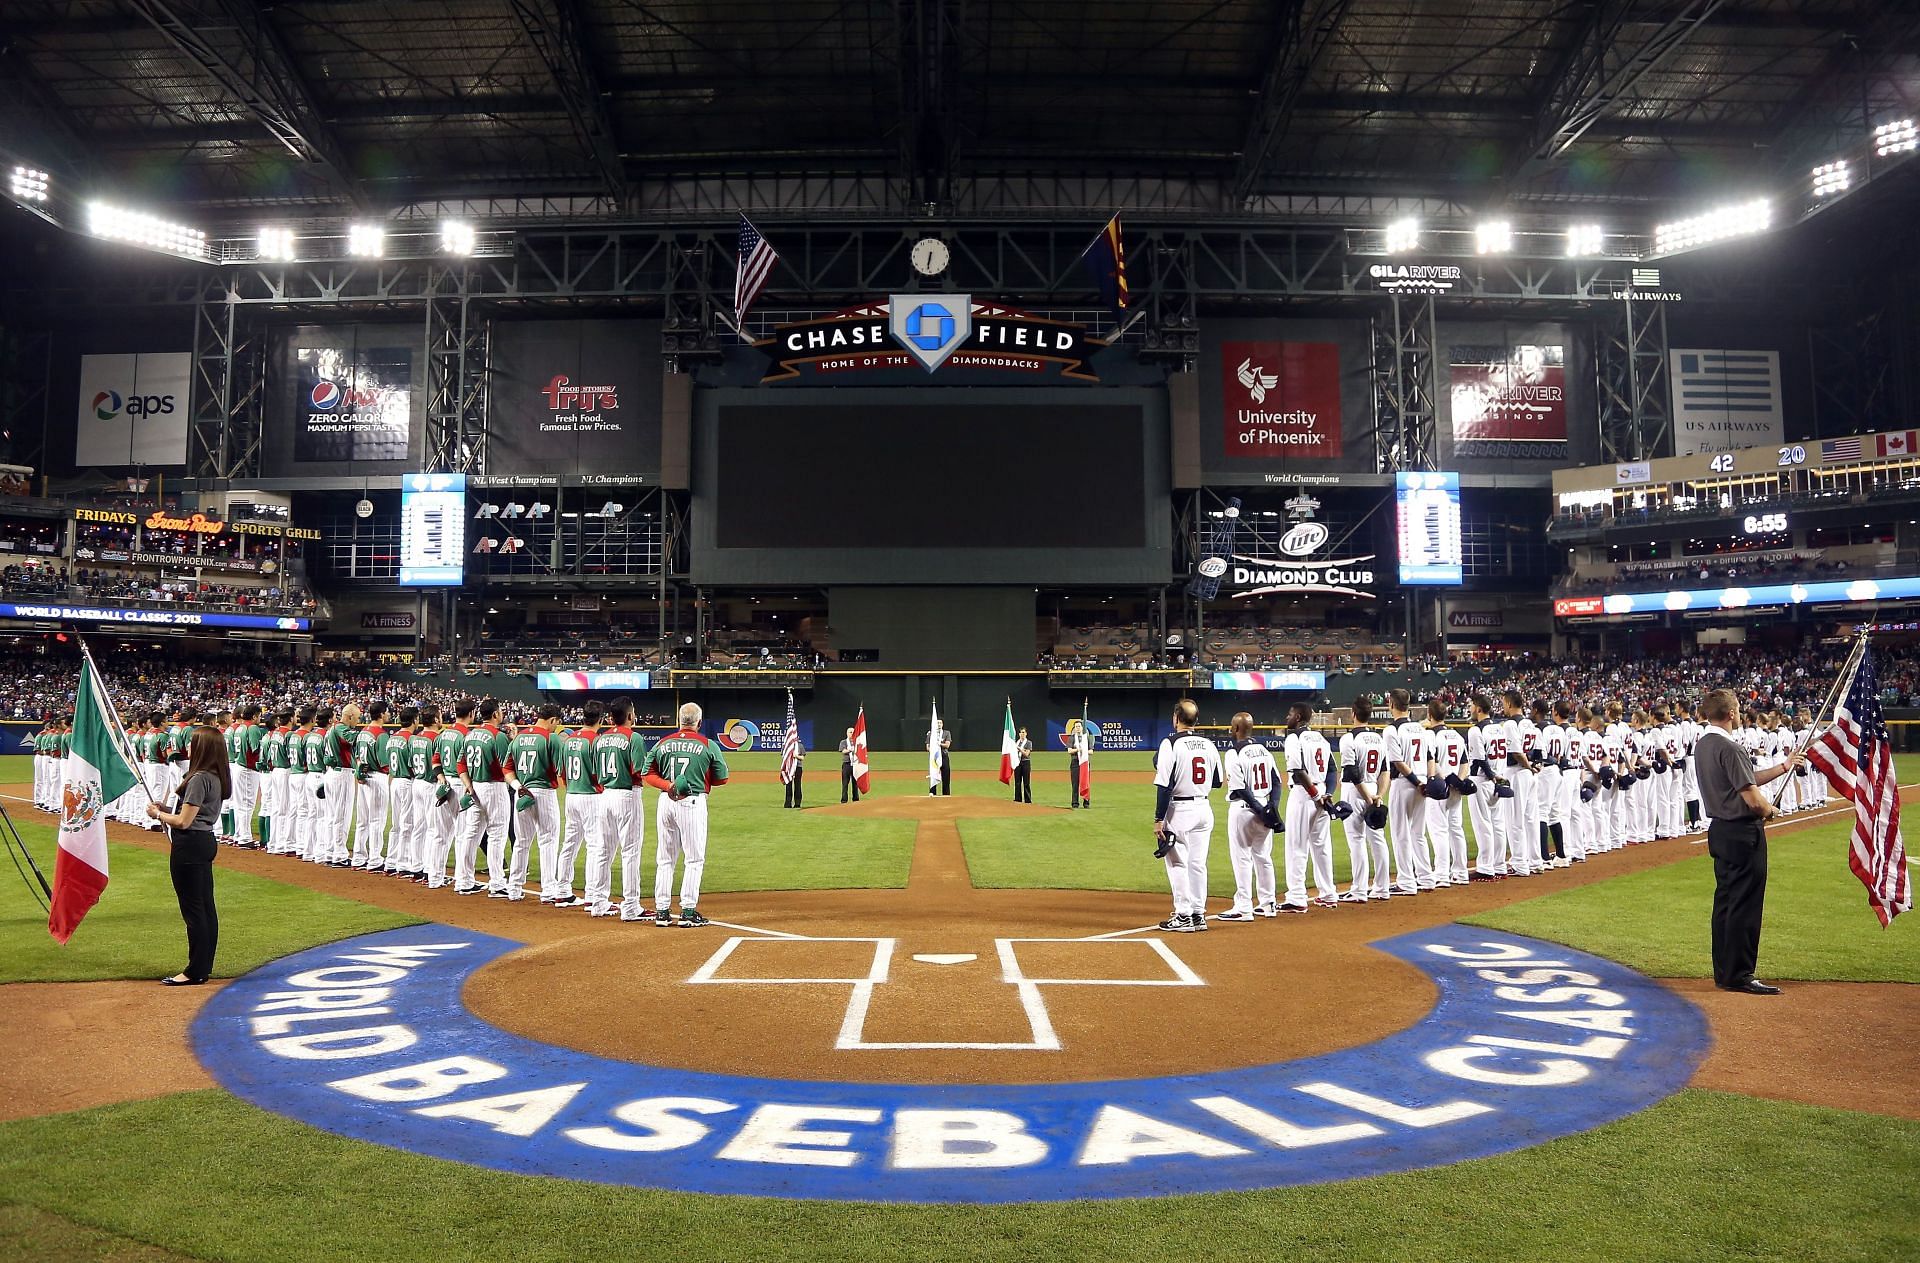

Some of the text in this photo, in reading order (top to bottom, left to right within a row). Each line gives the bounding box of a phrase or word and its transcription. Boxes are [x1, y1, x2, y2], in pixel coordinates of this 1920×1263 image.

[1632, 292, 1682, 301] AIRWAYS
[787, 325, 1073, 351] CHASE FIELD
[822, 360, 855, 369] HOME
[952, 357, 1039, 369] DIAMONDBACKS
[126, 395, 174, 419] aps
[309, 414, 338, 423] ZERO
[540, 422, 622, 431] Famous Low Prices.
[556, 414, 604, 423] Fresh Food.
[1238, 410, 1317, 428] University
[1708, 422, 1771, 432] AIRWAYS
[1239, 429, 1321, 444] of Phoenix
[1710, 454, 1734, 472] 42
[1778, 446, 1806, 466] 20
[473, 476, 557, 486] NL West Champions
[581, 475, 643, 485] NL Champions
[1265, 474, 1340, 484] World Champions
[75, 508, 137, 524] FRIDAY'S
[145, 510, 224, 534] Front Row
[1744, 514, 1788, 534] 6:55
[231, 523, 321, 540] SPORTS GRILL
[132, 553, 227, 567] FRONTROWPHOENIX.com
[1234, 567, 1373, 584] DIAMOND CLUB
[15, 606, 201, 625] WORLD BASEBALL CLASSIC 2013
[380, 618, 411, 626] FITNESS
[519, 737, 537, 746] CRUZ
[660, 742, 704, 755] RENTERIA
[1184, 740, 1206, 750] TORRE
[1412, 739, 1421, 761] 7
[1488, 739, 1506, 760] 35
[390, 751, 397, 772] 8
[413, 753, 426, 775] 95
[443, 745, 451, 767] 3
[467, 745, 482, 767] 23
[517, 751, 537, 774] 47
[1366, 750, 1379, 774] 8
[1448, 744, 1458, 766] 5
[568, 755, 581, 780] 19
[601, 752, 618, 778] 14
[671, 757, 690, 784] 17
[1192, 757, 1206, 784] 6
[1252, 762, 1268, 790] 11
[249, 942, 1636, 1170] WORLD BASEBALL CLASSIC
